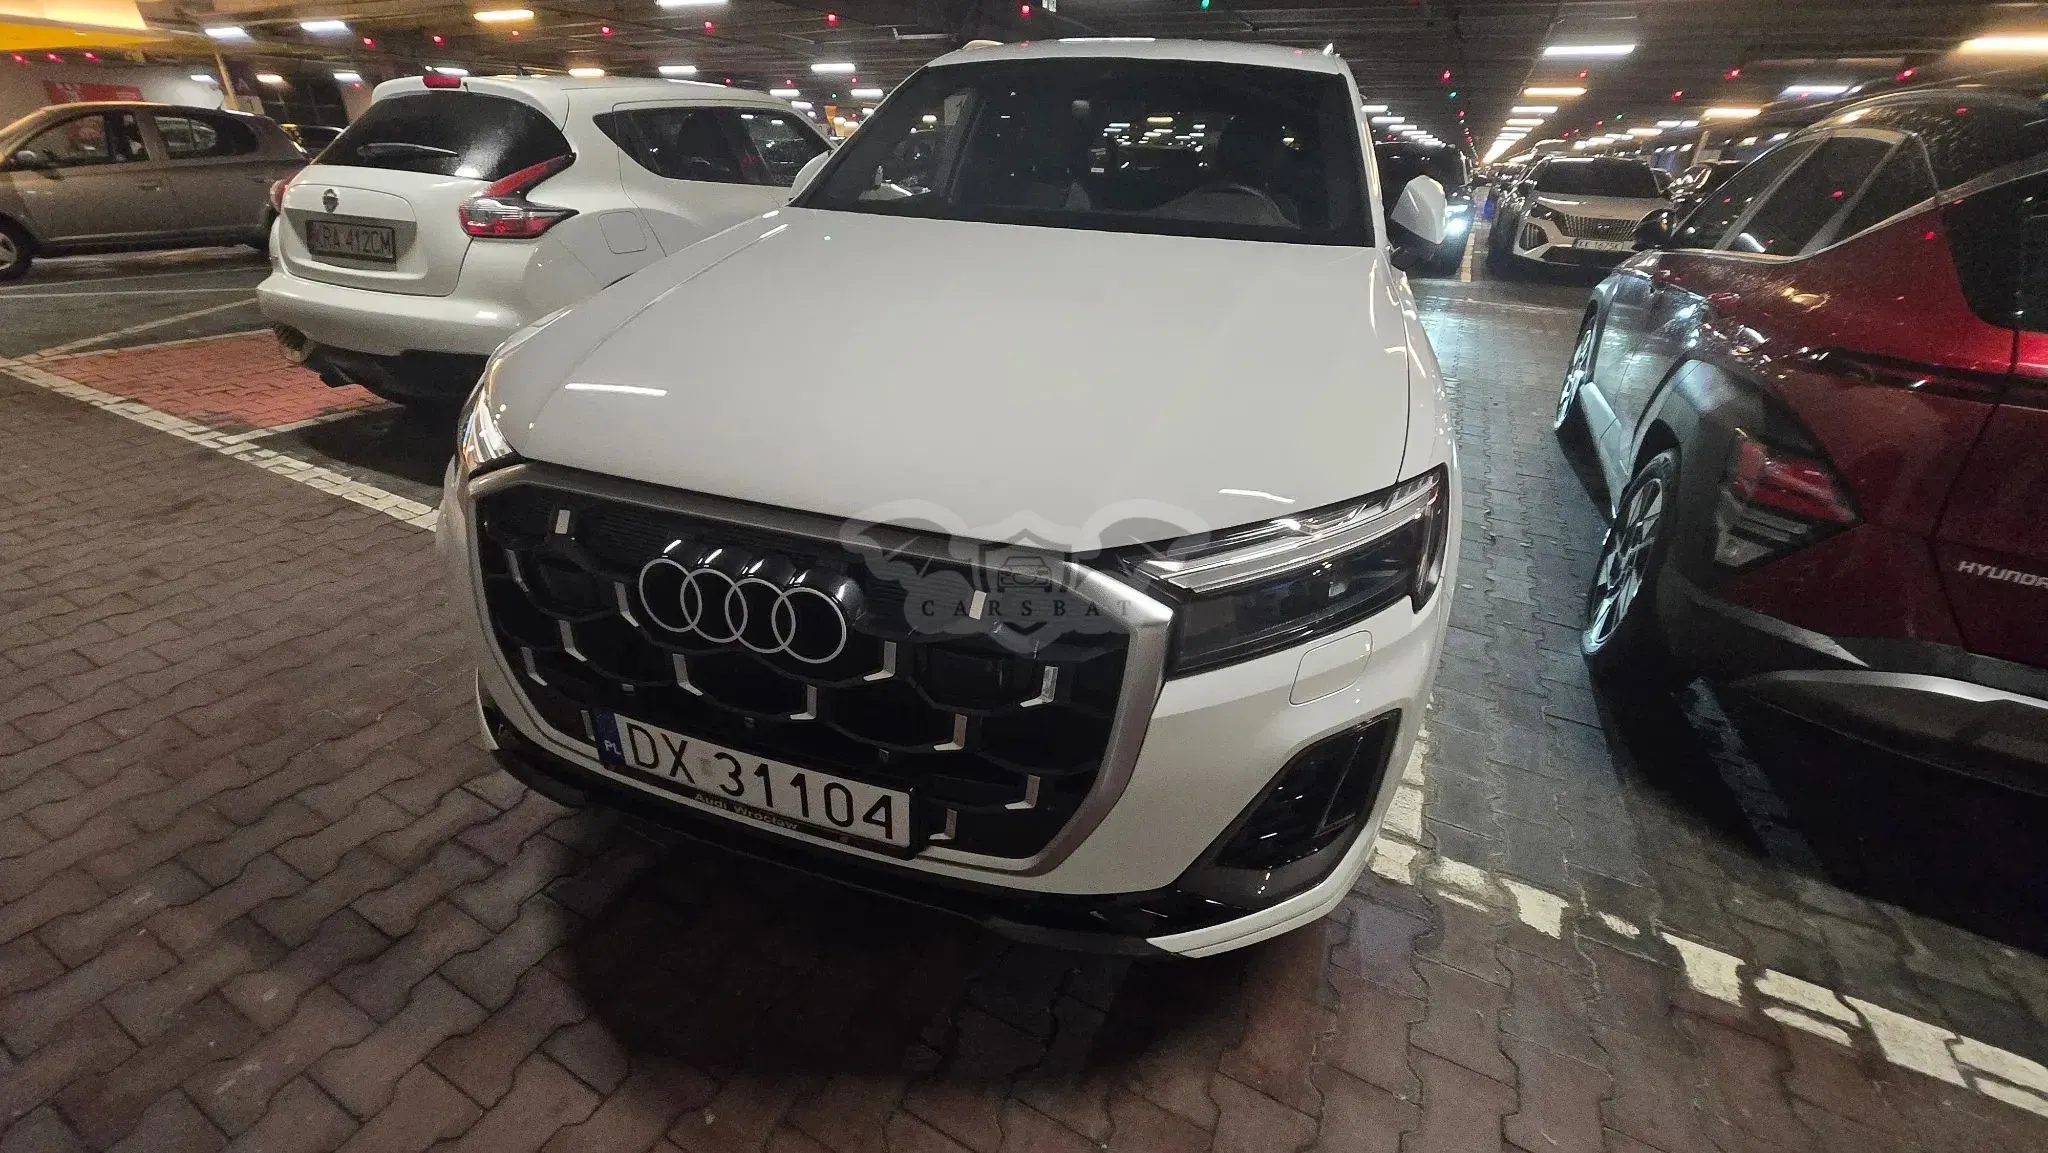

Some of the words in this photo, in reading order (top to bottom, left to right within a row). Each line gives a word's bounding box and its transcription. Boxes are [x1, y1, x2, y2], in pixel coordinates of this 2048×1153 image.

[345, 228, 391, 253] 412CM
[604, 739, 621, 755] PL
[626, 721, 696, 785] DX
[713, 751, 894, 840] 31104
[694, 793, 728, 810] Audi
[733, 805, 798, 830] Wrocław
